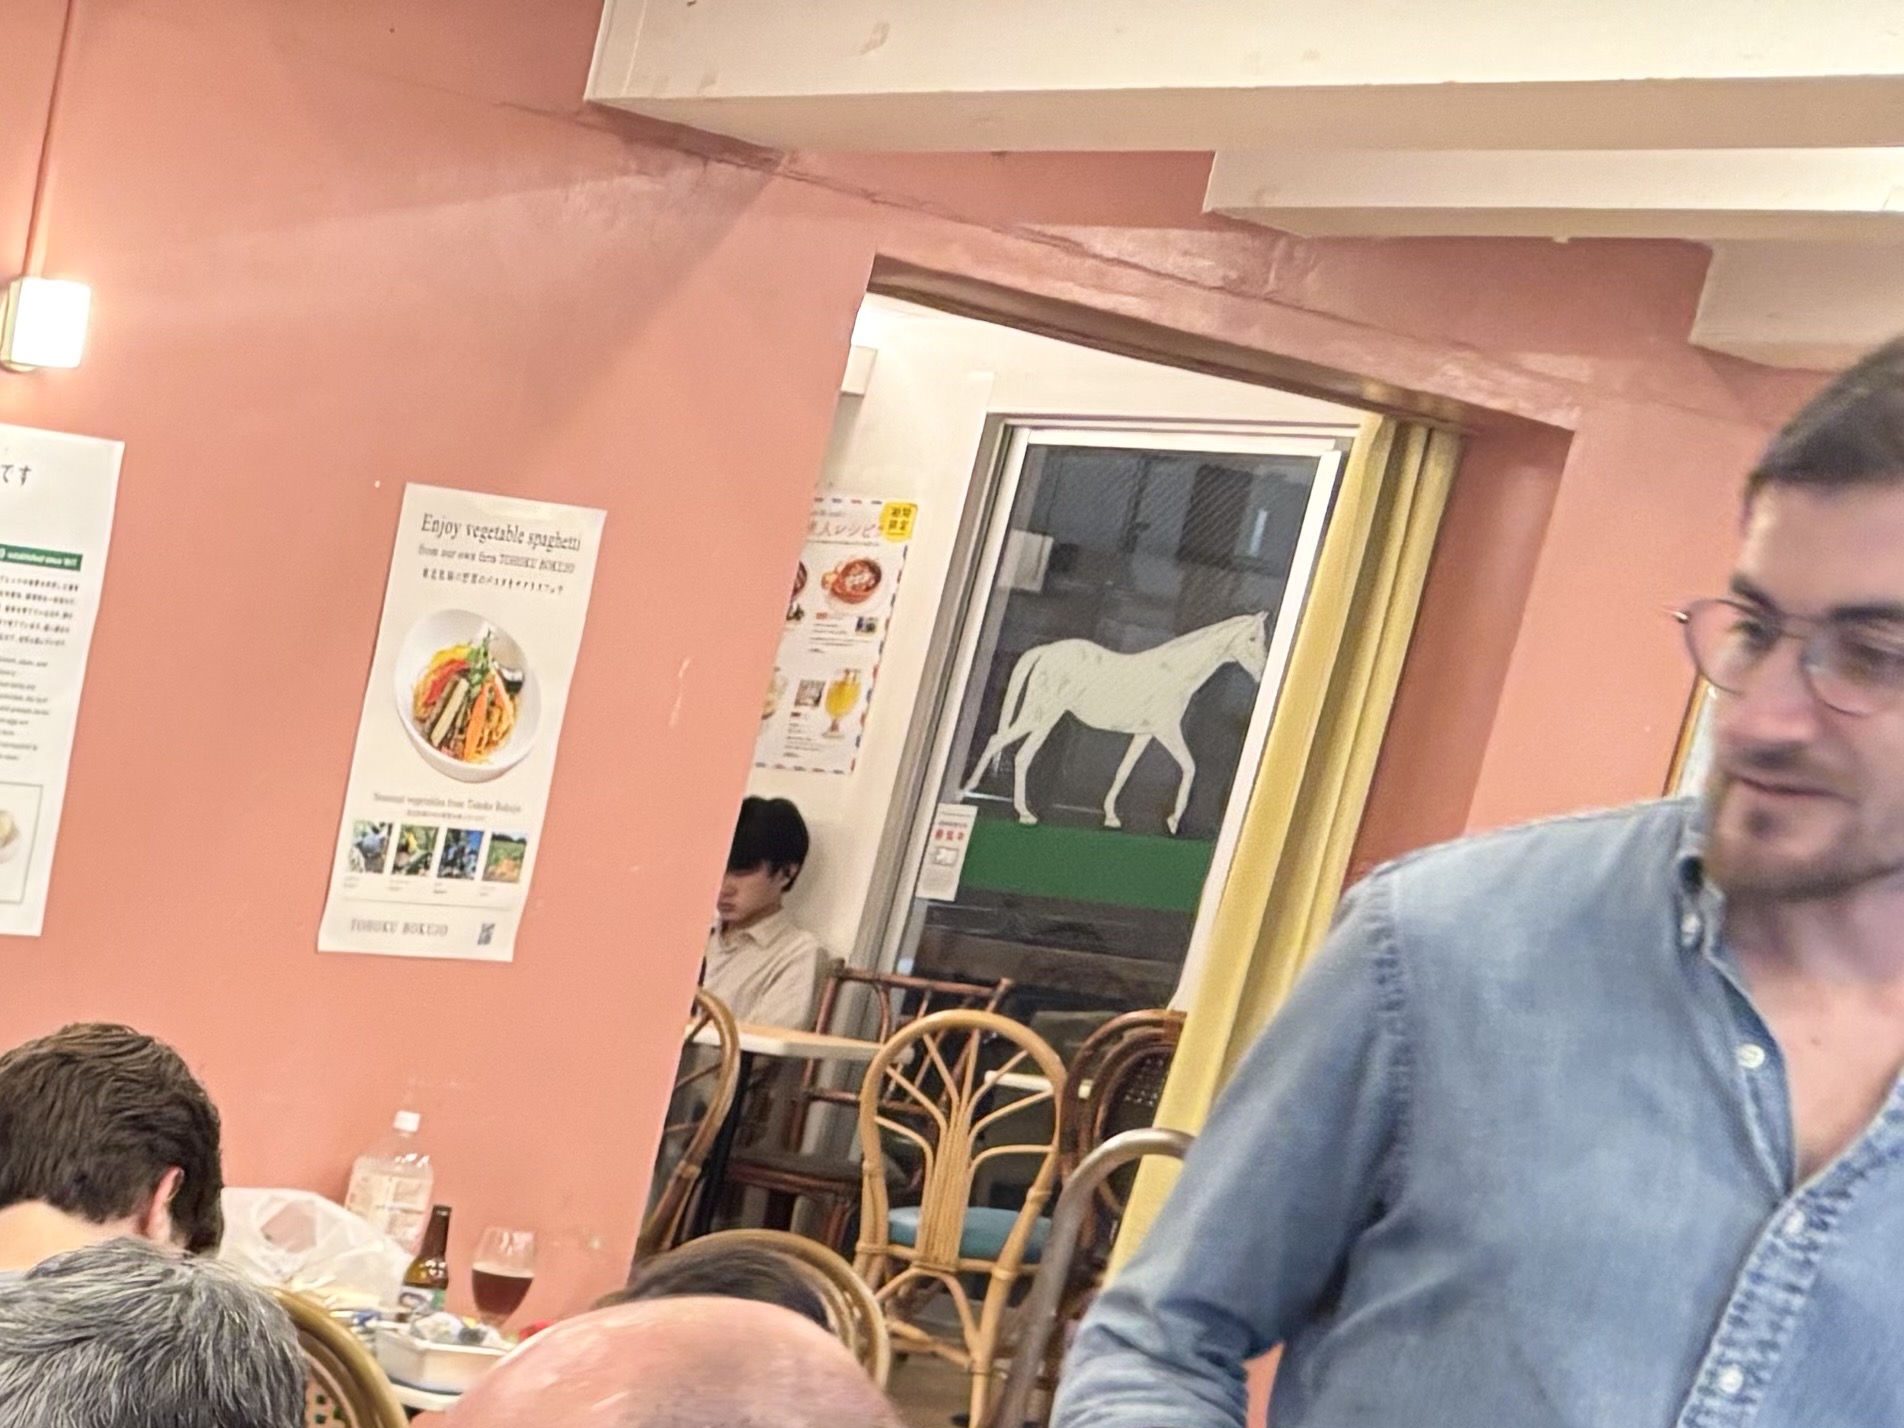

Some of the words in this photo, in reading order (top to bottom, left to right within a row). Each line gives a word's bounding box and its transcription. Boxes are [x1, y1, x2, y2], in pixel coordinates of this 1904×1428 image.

[421, 513, 460, 540] Enjoy
[466, 523, 525, 544] vegetable
[527, 531, 581, 552] spaghetti
